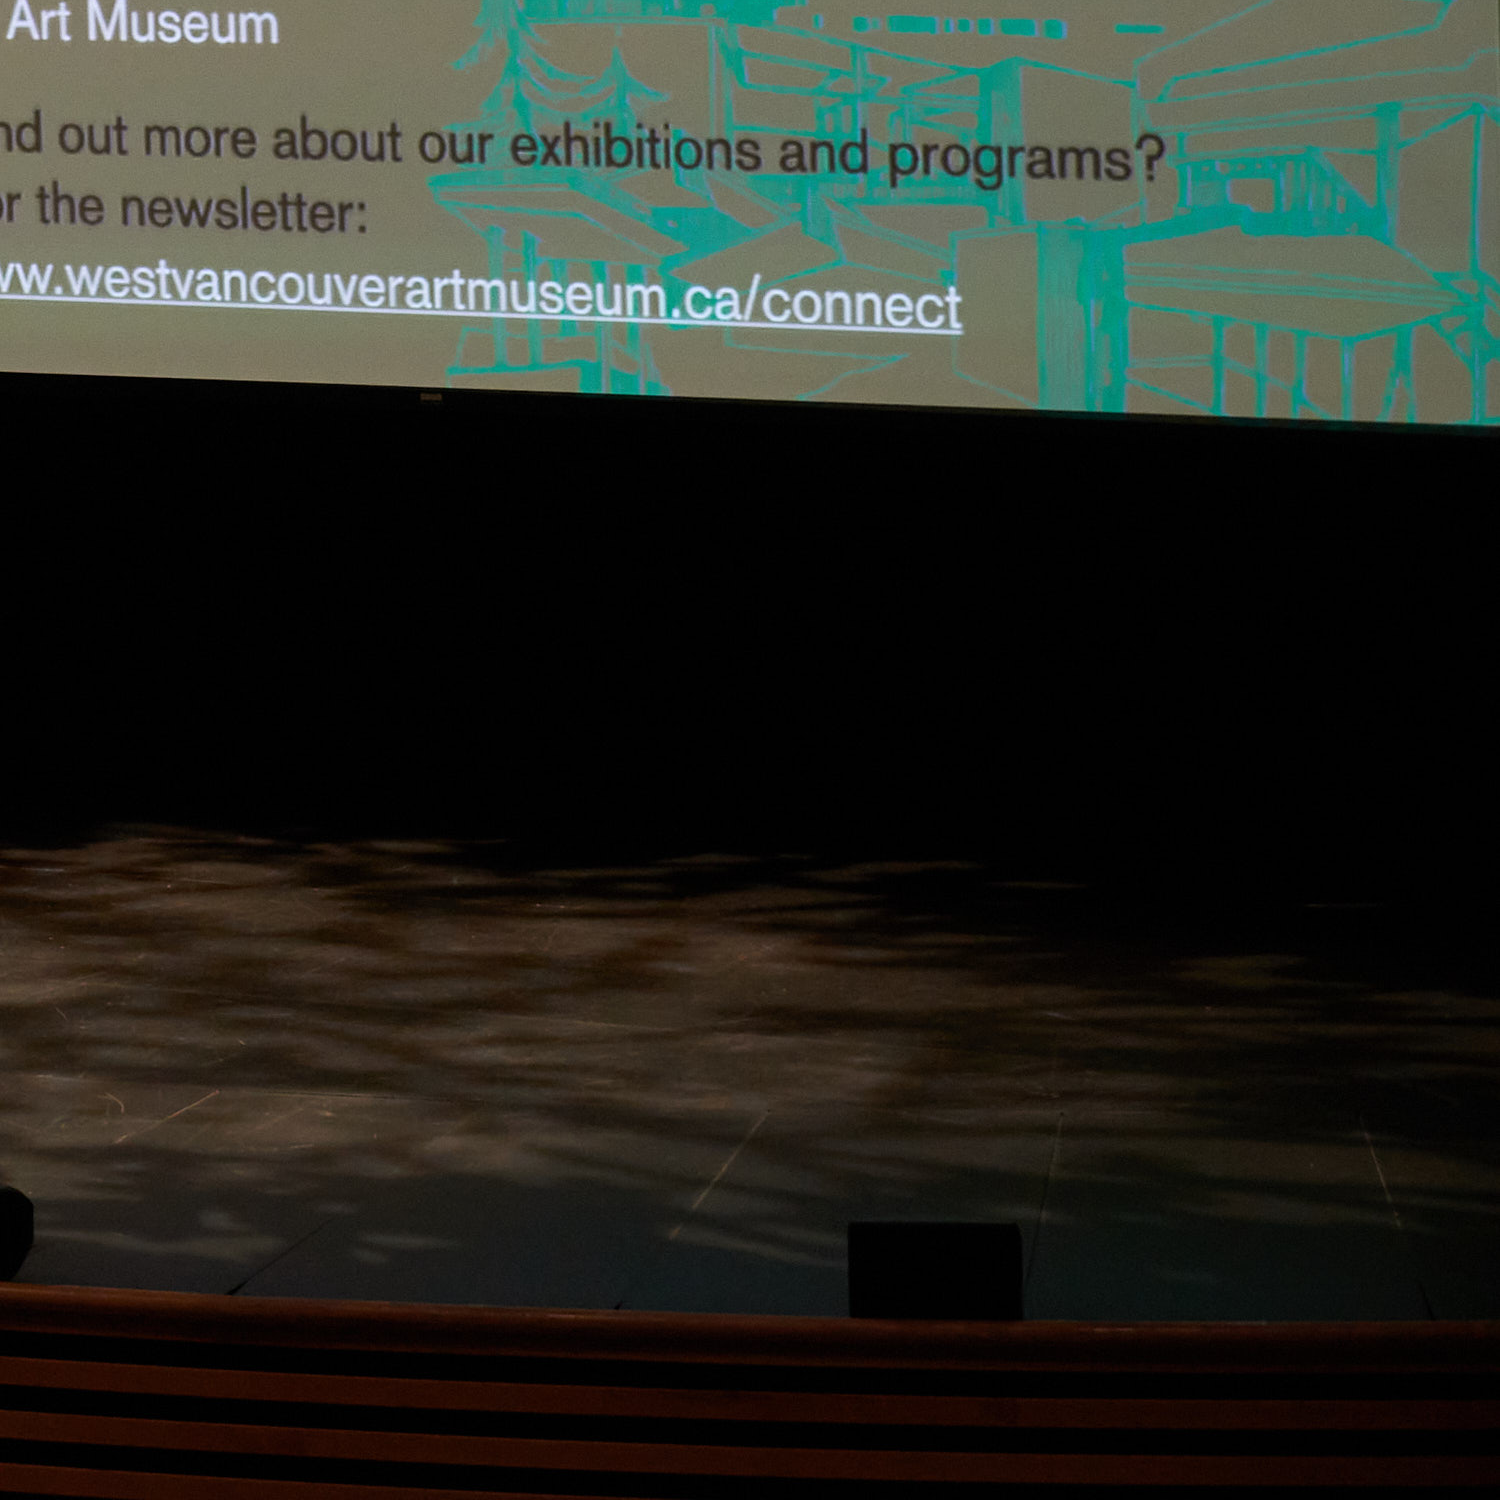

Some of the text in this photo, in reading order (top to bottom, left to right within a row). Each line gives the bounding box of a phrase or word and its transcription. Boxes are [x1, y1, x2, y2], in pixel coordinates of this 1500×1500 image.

[58, 115, 128, 158] out
[143, 122, 257, 160] more
[273, 114, 402, 164] about
[418, 129, 494, 166] our
[509, 124, 763, 173] exhibitions
[778, 129, 870, 176] and
[887, 134, 1167, 191] programs?
[36, 180, 104, 227] the
[121, 185, 368, 234] newsletter:
